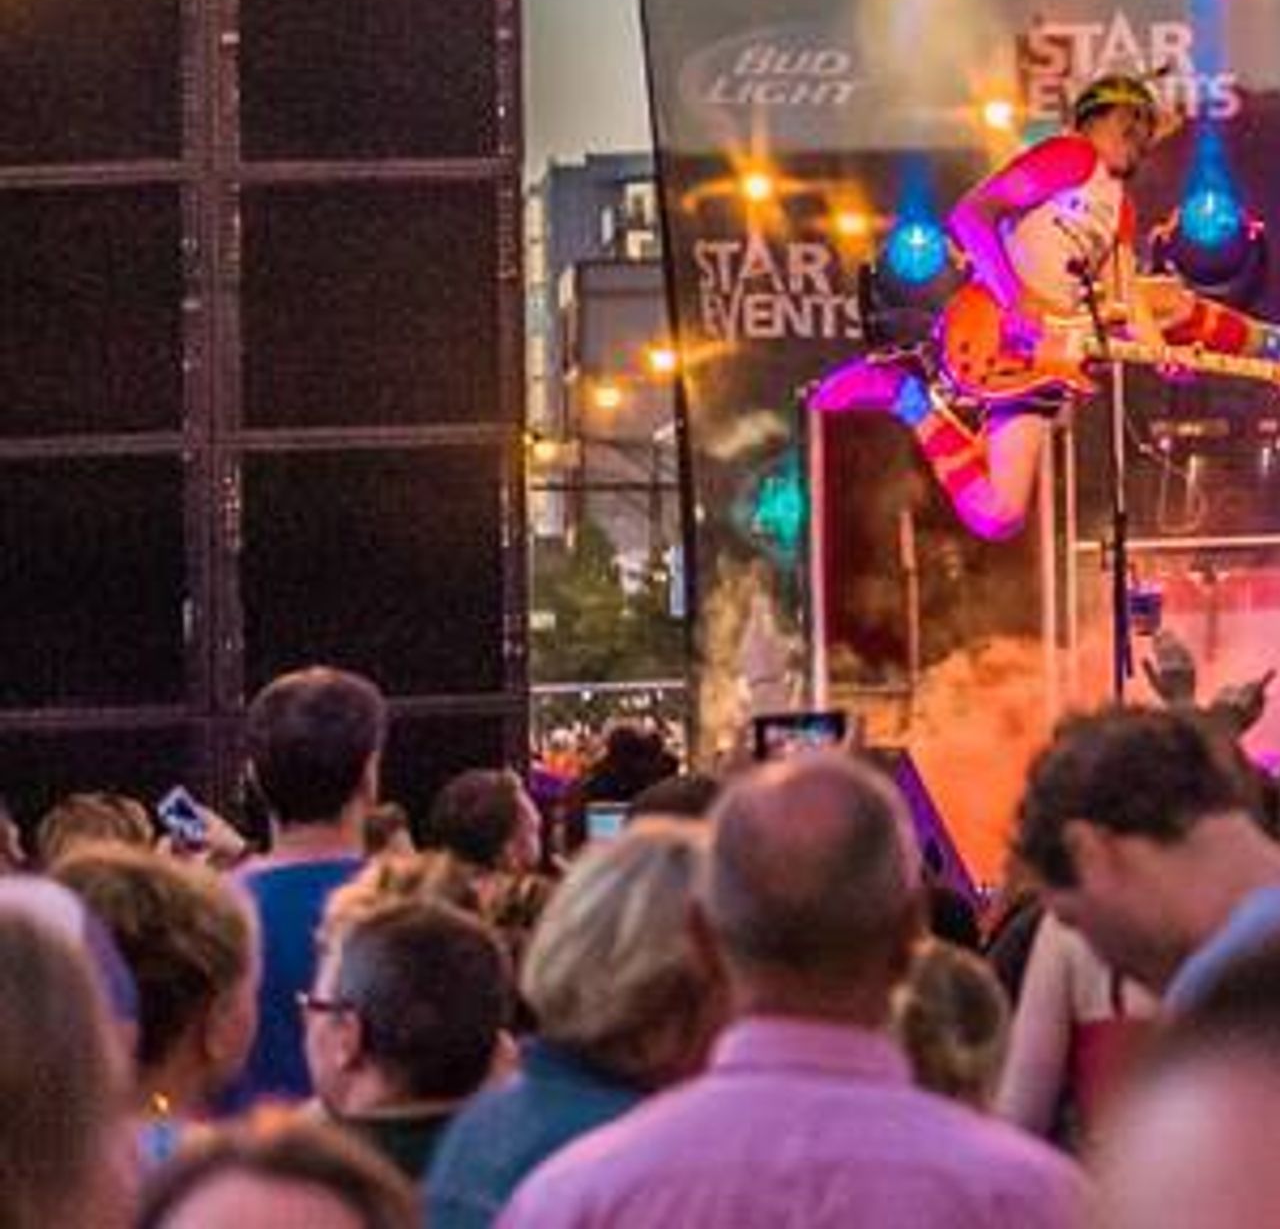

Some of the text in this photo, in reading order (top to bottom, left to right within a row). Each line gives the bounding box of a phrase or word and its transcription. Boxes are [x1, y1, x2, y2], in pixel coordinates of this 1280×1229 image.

[733, 43, 851, 76] BUD
[1027, 7, 1195, 75] STAR
[703, 77, 856, 105] LIGHT
[694, 231, 833, 294] STAR
